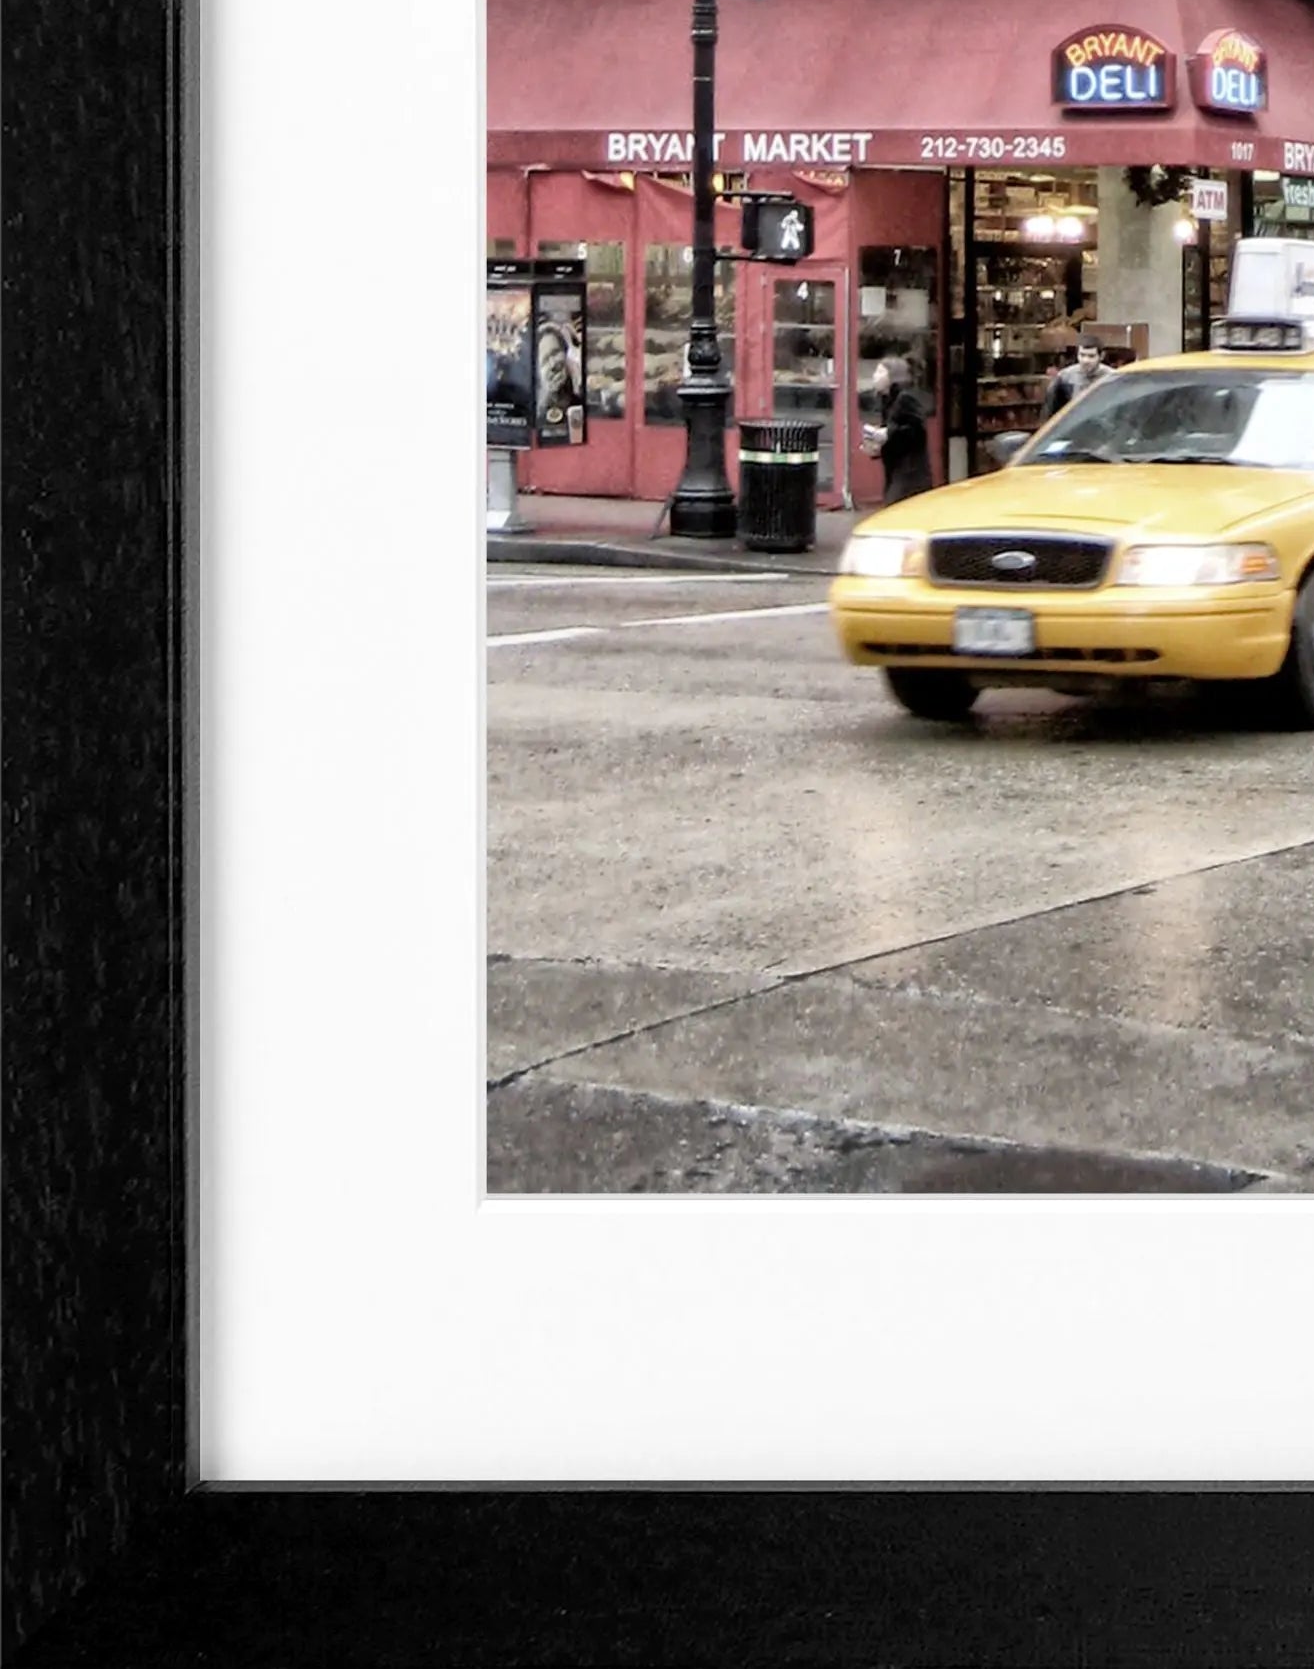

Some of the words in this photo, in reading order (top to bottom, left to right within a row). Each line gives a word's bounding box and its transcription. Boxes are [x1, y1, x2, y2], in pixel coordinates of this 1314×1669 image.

[1064, 32, 1165, 67] BRYANT
[1212, 37, 1259, 73] BRYANT
[1070, 63, 1157, 101] DELI
[1212, 66, 1257, 106] DELI
[742, 133, 873, 163] MARKET
[920, 136, 1067, 160] 212-730-2345
[1231, 142, 1254, 162] 1017
[1197, 189, 1225, 212] ATM
[576, 243, 588, 260] 5
[796, 281, 809, 300] 4
